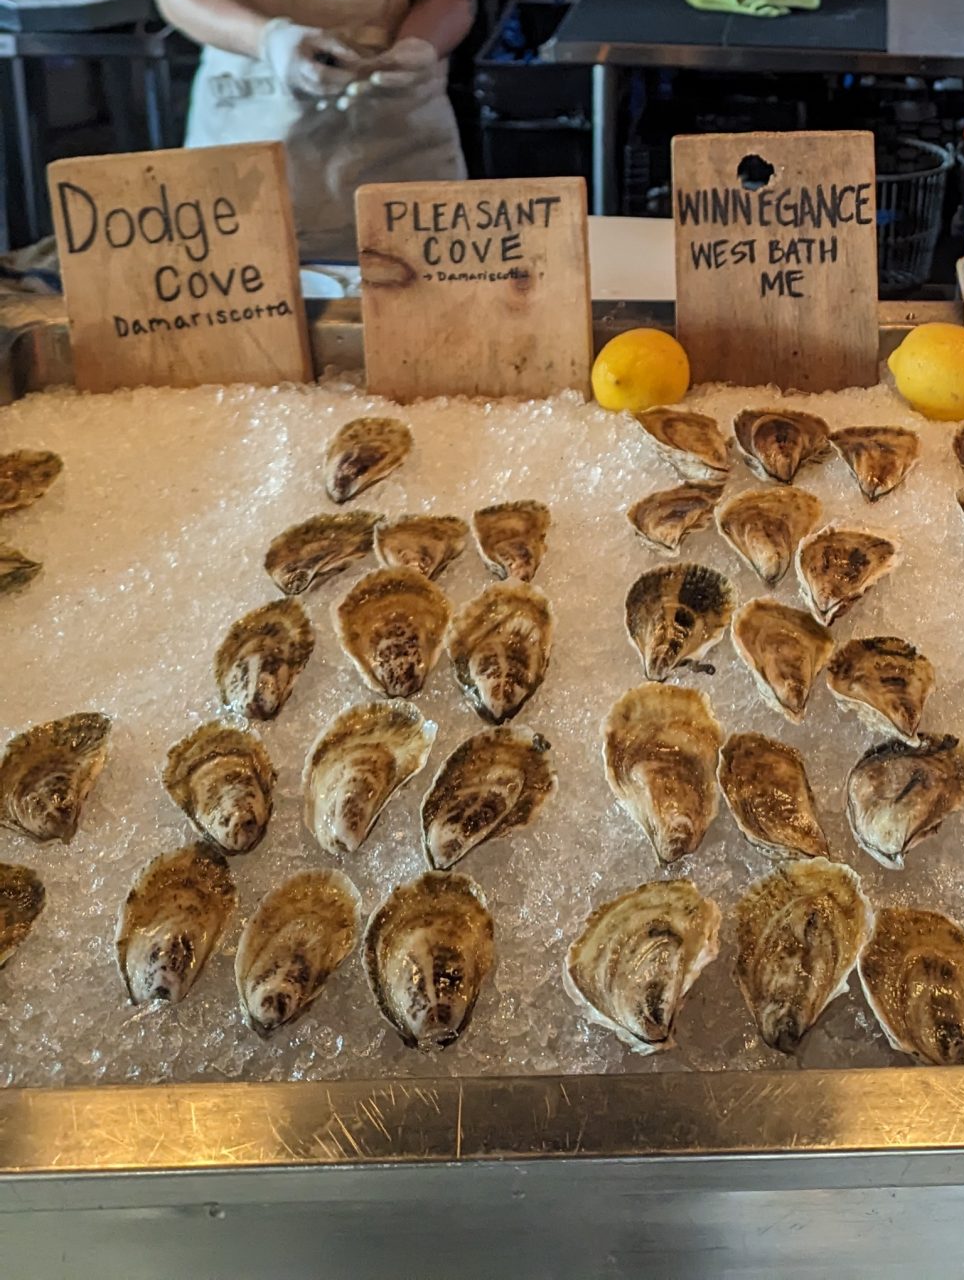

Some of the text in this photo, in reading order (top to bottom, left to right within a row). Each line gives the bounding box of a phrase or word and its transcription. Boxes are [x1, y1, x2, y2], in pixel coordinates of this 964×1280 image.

[58, 182, 240, 262] Dodge
[384, 196, 561, 232] PLEASANT
[677, 182, 873, 229] WINNEGANCE
[422, 233, 524, 266] COVE
[690, 235, 838, 270] WEST BATH
[760, 270, 805, 297] ME
